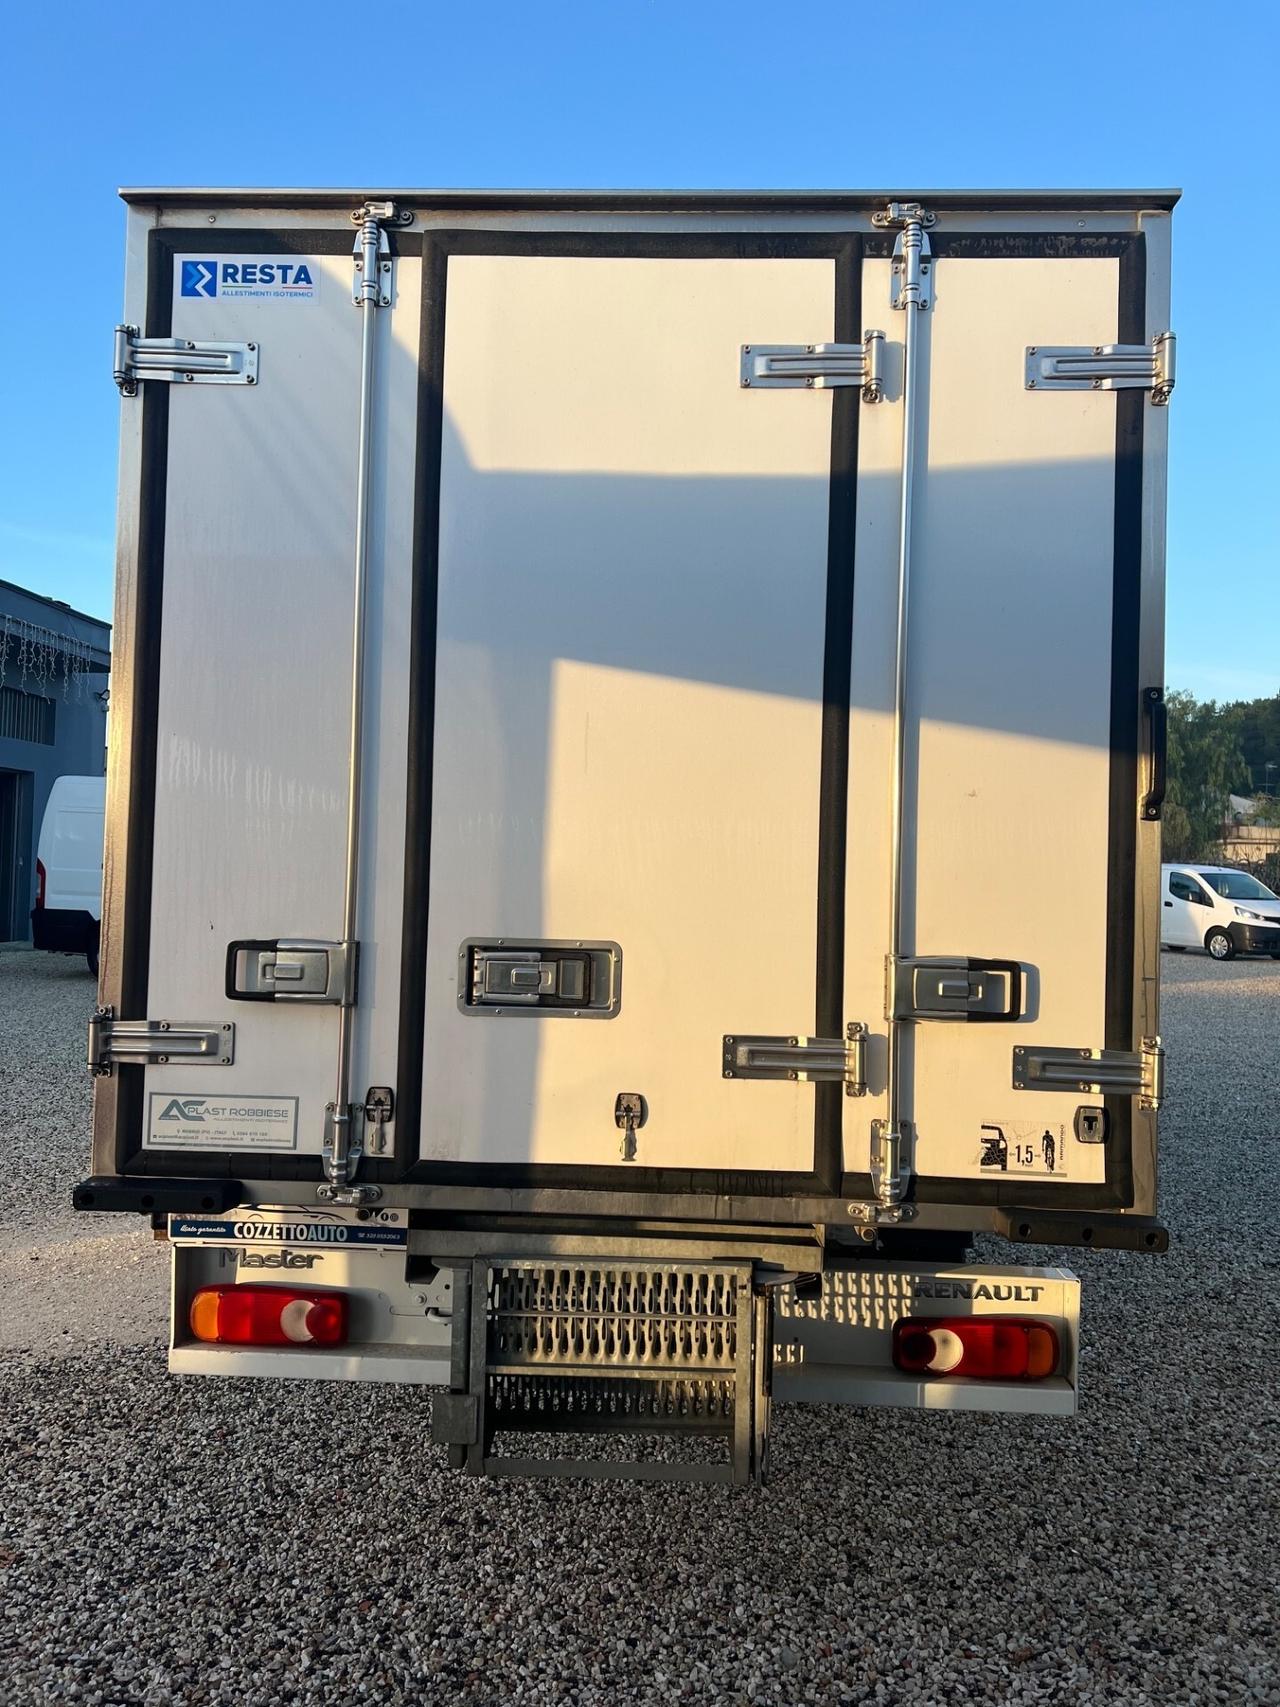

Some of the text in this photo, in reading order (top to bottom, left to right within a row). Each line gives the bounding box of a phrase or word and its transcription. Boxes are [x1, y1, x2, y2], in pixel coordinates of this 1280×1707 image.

[222, 263, 313, 285] RESTA
[221, 289, 313, 298] ALLESTIMENTI ISOTERMICI
[229, 1107, 289, 1118] ROBBIESE
[1015, 1144, 1034, 1167] 1,5
[233, 1222, 348, 1243] COZZETTOAUTO
[219, 1248, 325, 1270] Master
[914, 1281, 1045, 1302] RENAULT
